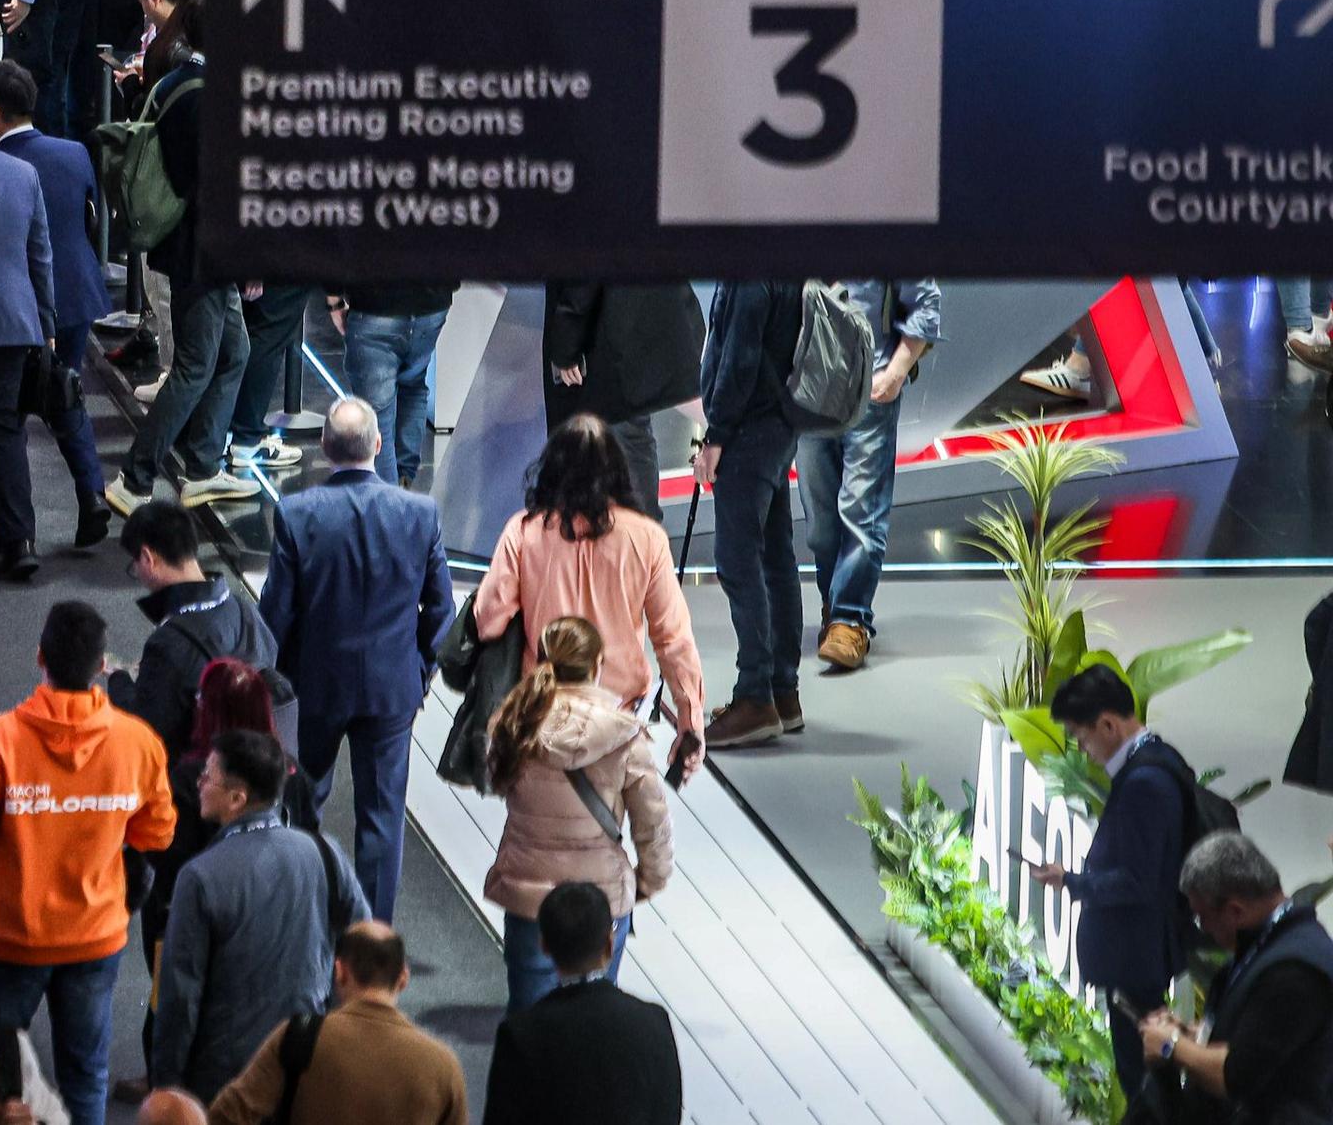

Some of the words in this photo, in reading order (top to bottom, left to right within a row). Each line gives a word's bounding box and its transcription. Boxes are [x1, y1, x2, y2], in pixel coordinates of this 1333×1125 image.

[241, 68, 403, 100] Premium
[414, 68, 591, 100] Executive
[740, 4, 860, 169] 3
[240, 105, 387, 141] Meeting
[399, 105, 524, 136] Rooms
[240, 158, 416, 191] Executive
[427, 158, 575, 193] Meeting
[1104, 144, 1208, 182] Food
[239, 196, 363, 228] Rooms
[375, 195, 501, 230] (West)
[1148, 186, 1333, 229] Courtyar
[5, 794, 138, 815] EXPLORERS
[6, 784, 51, 798] XIAOMI
